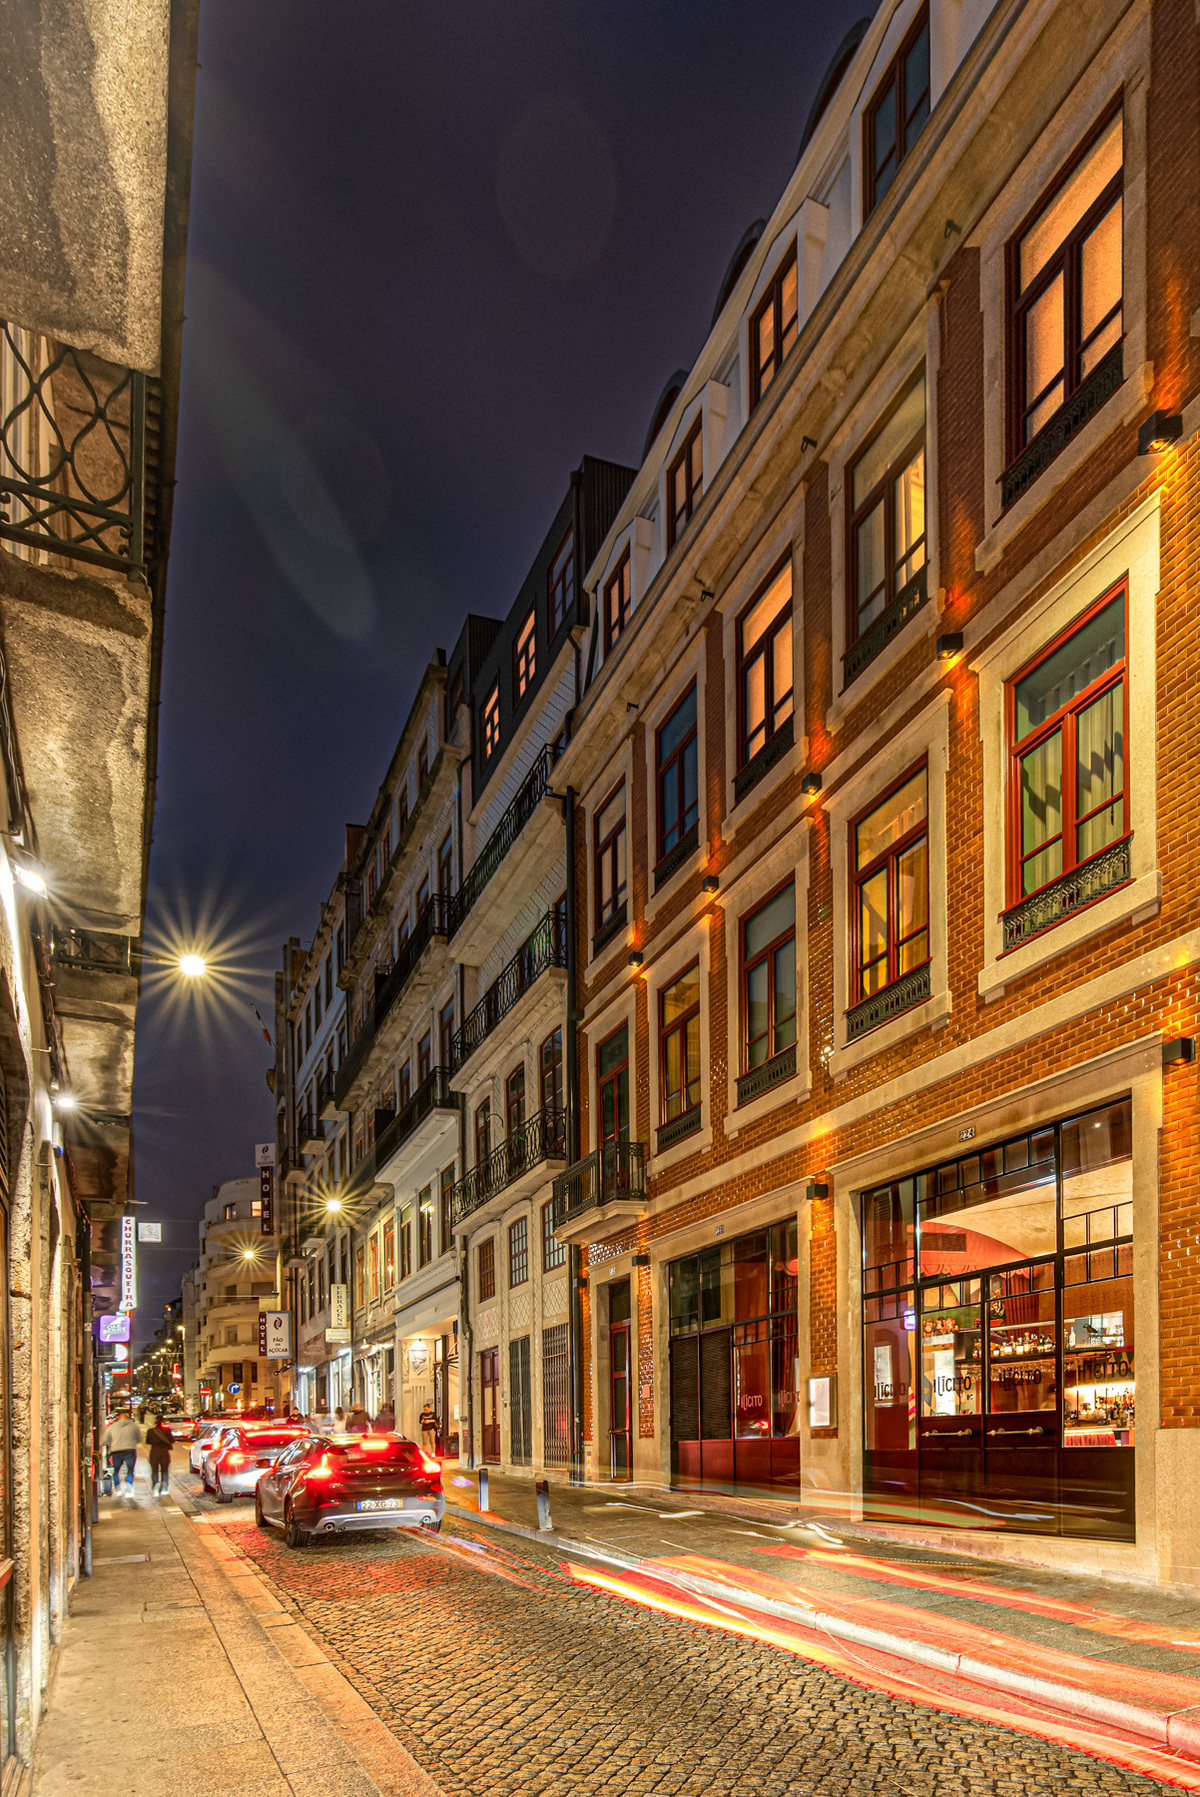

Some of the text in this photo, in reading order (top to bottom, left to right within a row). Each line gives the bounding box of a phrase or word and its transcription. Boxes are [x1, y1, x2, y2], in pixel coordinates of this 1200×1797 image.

[959, 1127, 975, 1142] 224
[262, 1170, 270, 1232] HOTEL
[124, 1219, 133, 1307] CHURRASQUEIRA
